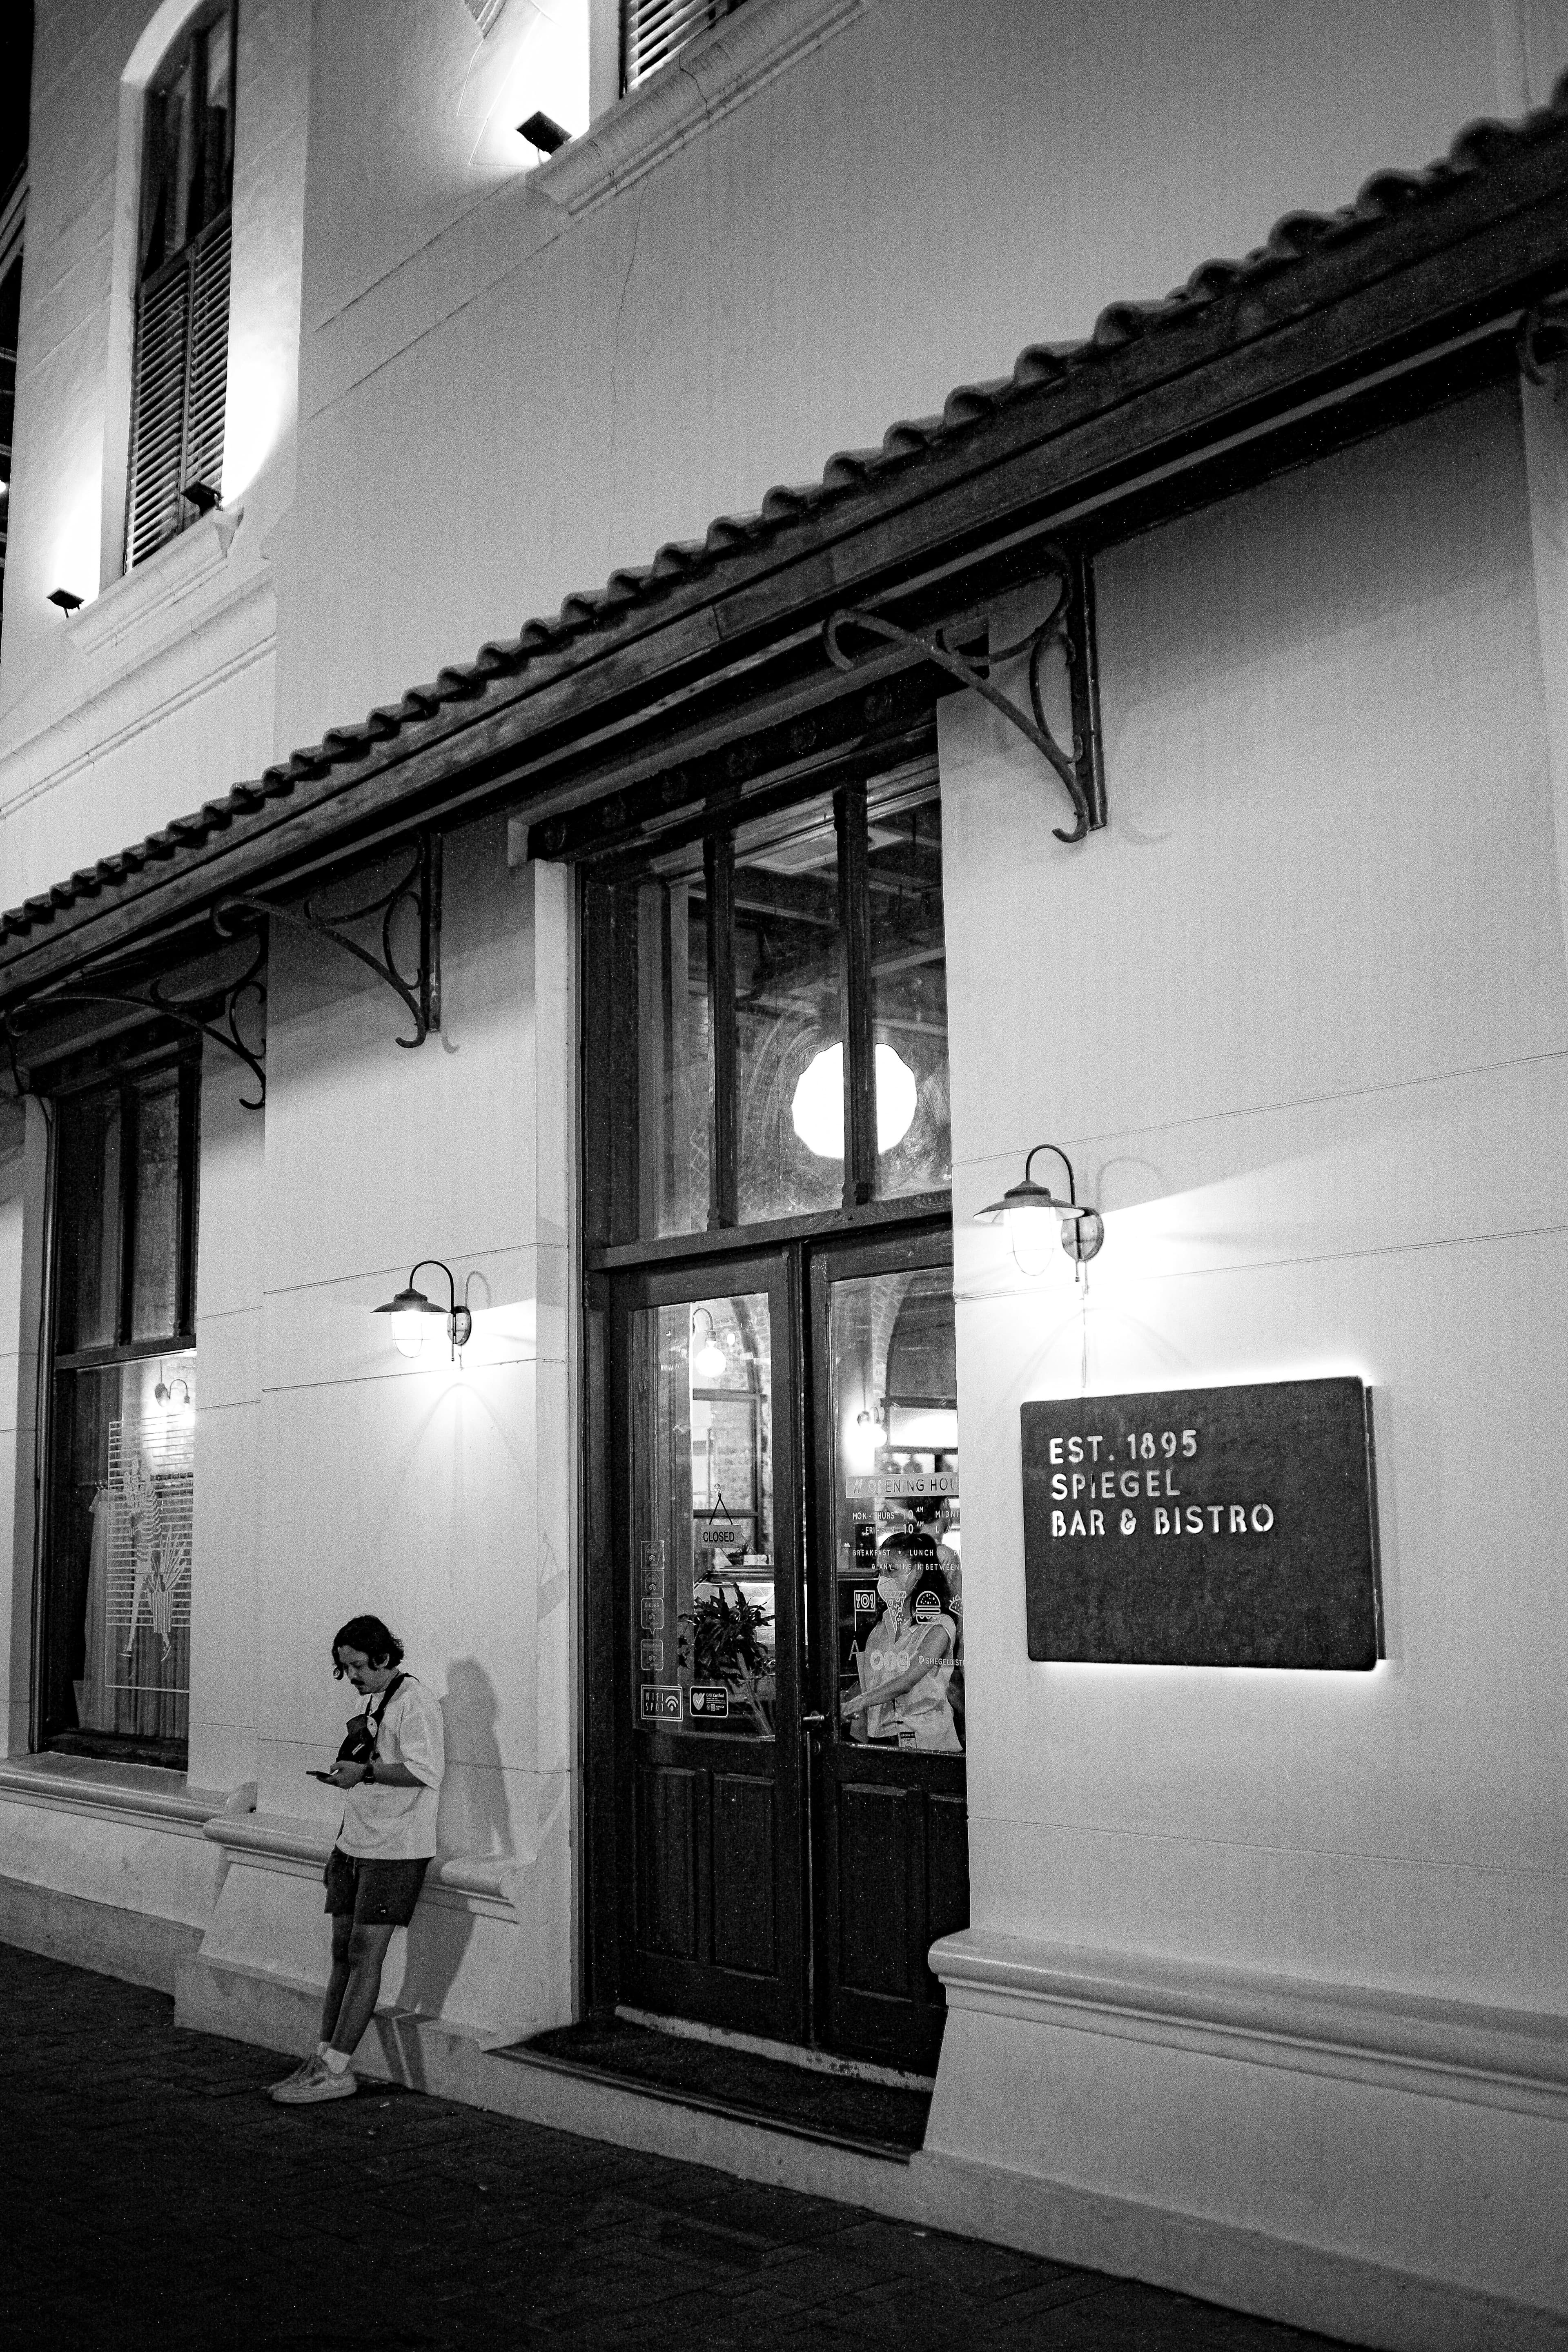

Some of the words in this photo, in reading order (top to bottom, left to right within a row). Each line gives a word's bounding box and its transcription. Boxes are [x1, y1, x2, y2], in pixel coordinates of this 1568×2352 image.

[1049, 1435, 1115, 1464] EST.
[1127, 1429, 1198, 1460] 1895
[867, 1478, 924, 1494] OPENING
[1051, 1469, 1181, 1501] SPIEGEL
[903, 1509, 914, 1520] 10
[1051, 1509, 1106, 1537] BAR
[1120, 1508, 1137, 1535] &
[1154, 1503, 1275, 1535] BISTRO
[903, 1523, 914, 1534] 10
[703, 1531, 735, 1542] CLOSED
[646, 1692, 664, 1702] WIFI
[646, 1702, 664, 1712] SPOT
